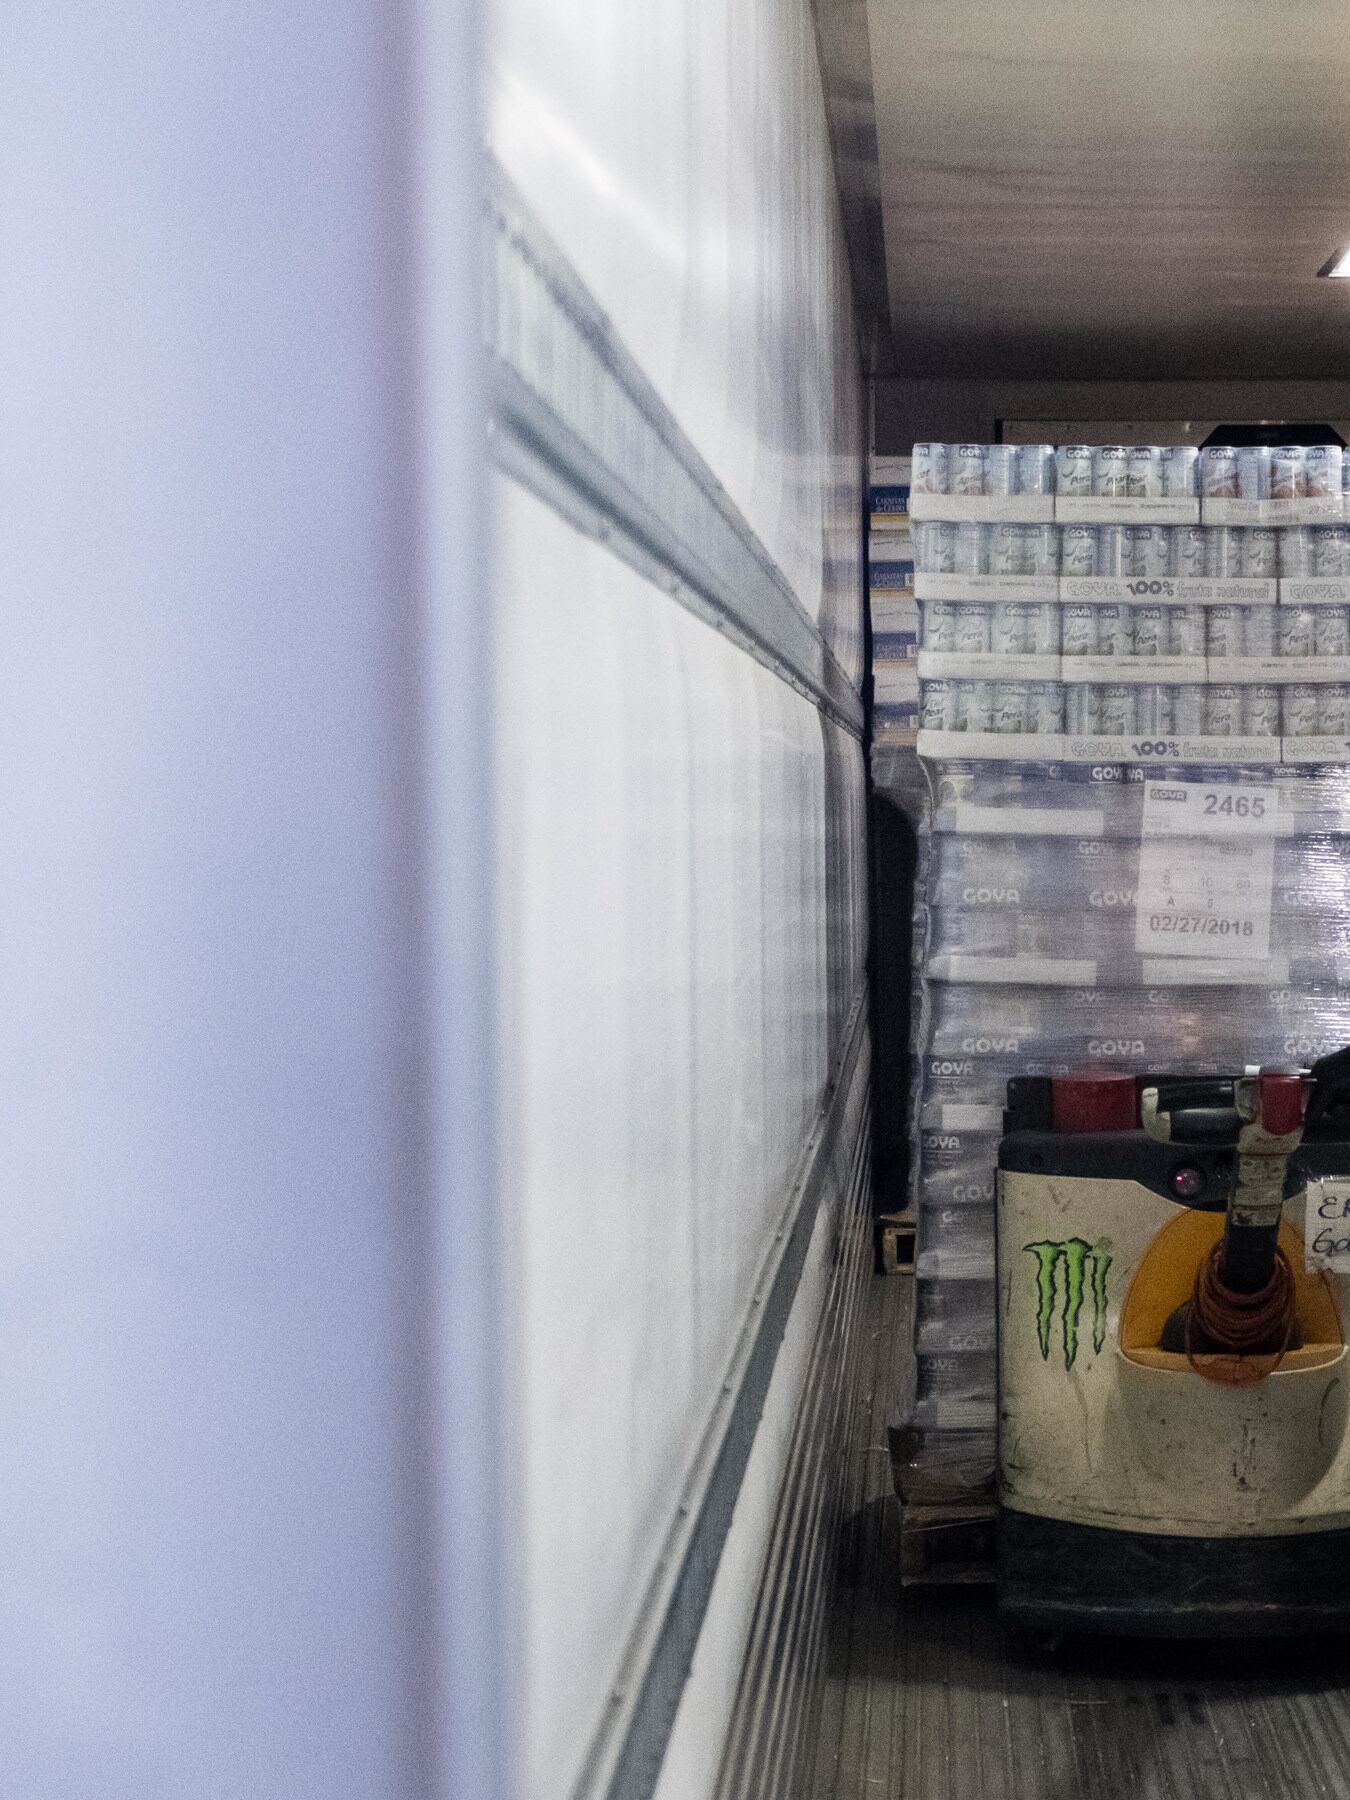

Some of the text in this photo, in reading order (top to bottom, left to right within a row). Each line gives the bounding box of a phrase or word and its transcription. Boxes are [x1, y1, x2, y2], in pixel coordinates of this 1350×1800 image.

[1127, 581, 1175, 597] 100%
[1132, 741, 1180, 757] 100%
[1203, 794, 1265, 817] 2465
[1150, 916, 1253, 936] 02/27/2018
[1088, 1039, 1145, 1056] GOYA
